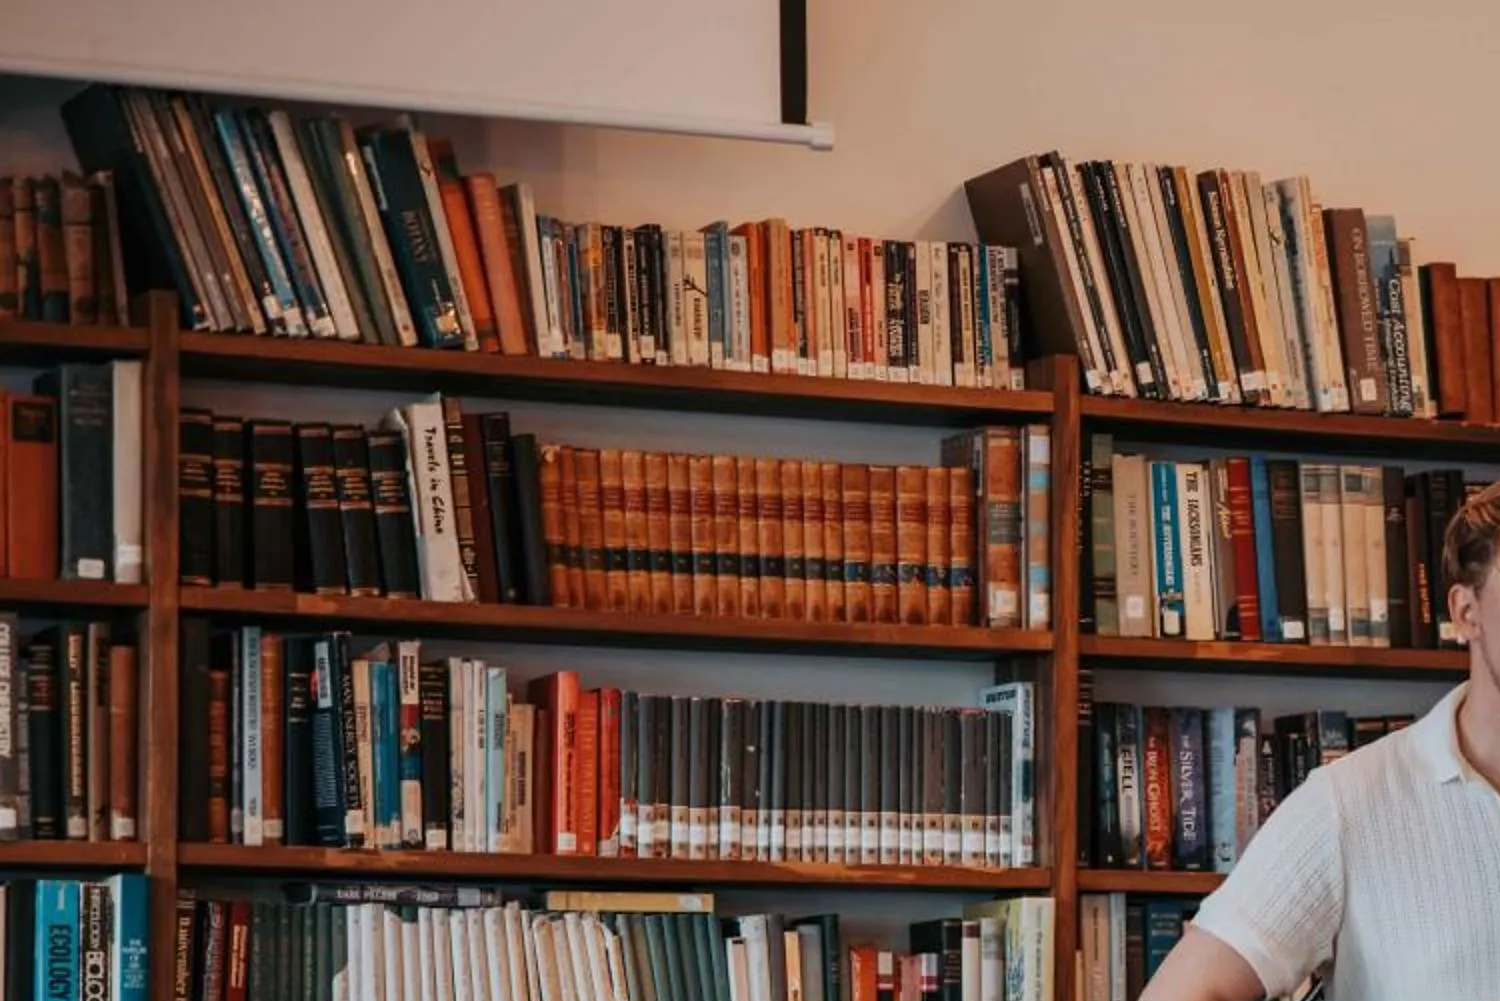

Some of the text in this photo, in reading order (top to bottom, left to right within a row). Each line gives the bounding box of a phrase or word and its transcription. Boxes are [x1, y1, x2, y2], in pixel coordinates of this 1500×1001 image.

[1389, 279, 1412, 411] Cost Accounting
[423, 427, 444, 535] Travels in China
[1185, 472, 1203, 567] THE JACKSONIANS
[1148, 783, 1160, 832] GHOST
[1179, 751, 1193, 804] SILVER
[1182, 806, 1196, 840] TIDE
[50, 926, 72, 1001] ECOLOGY
